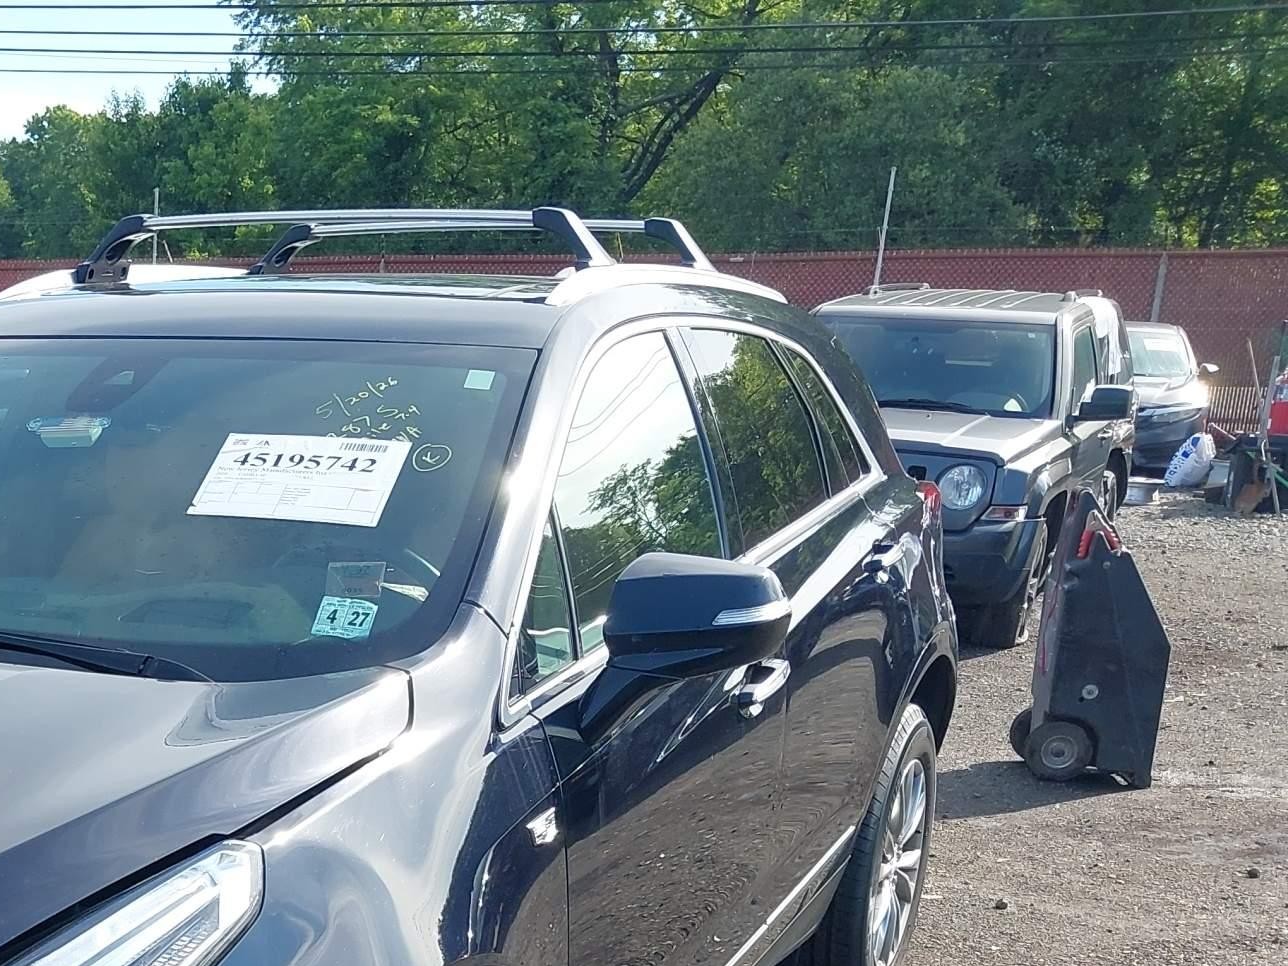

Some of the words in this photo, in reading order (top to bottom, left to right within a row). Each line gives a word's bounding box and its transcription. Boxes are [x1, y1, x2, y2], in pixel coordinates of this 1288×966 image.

[233, 452, 377, 473] 45195742
[326, 609, 338, 625] 4
[347, 611, 371, 628] 27
